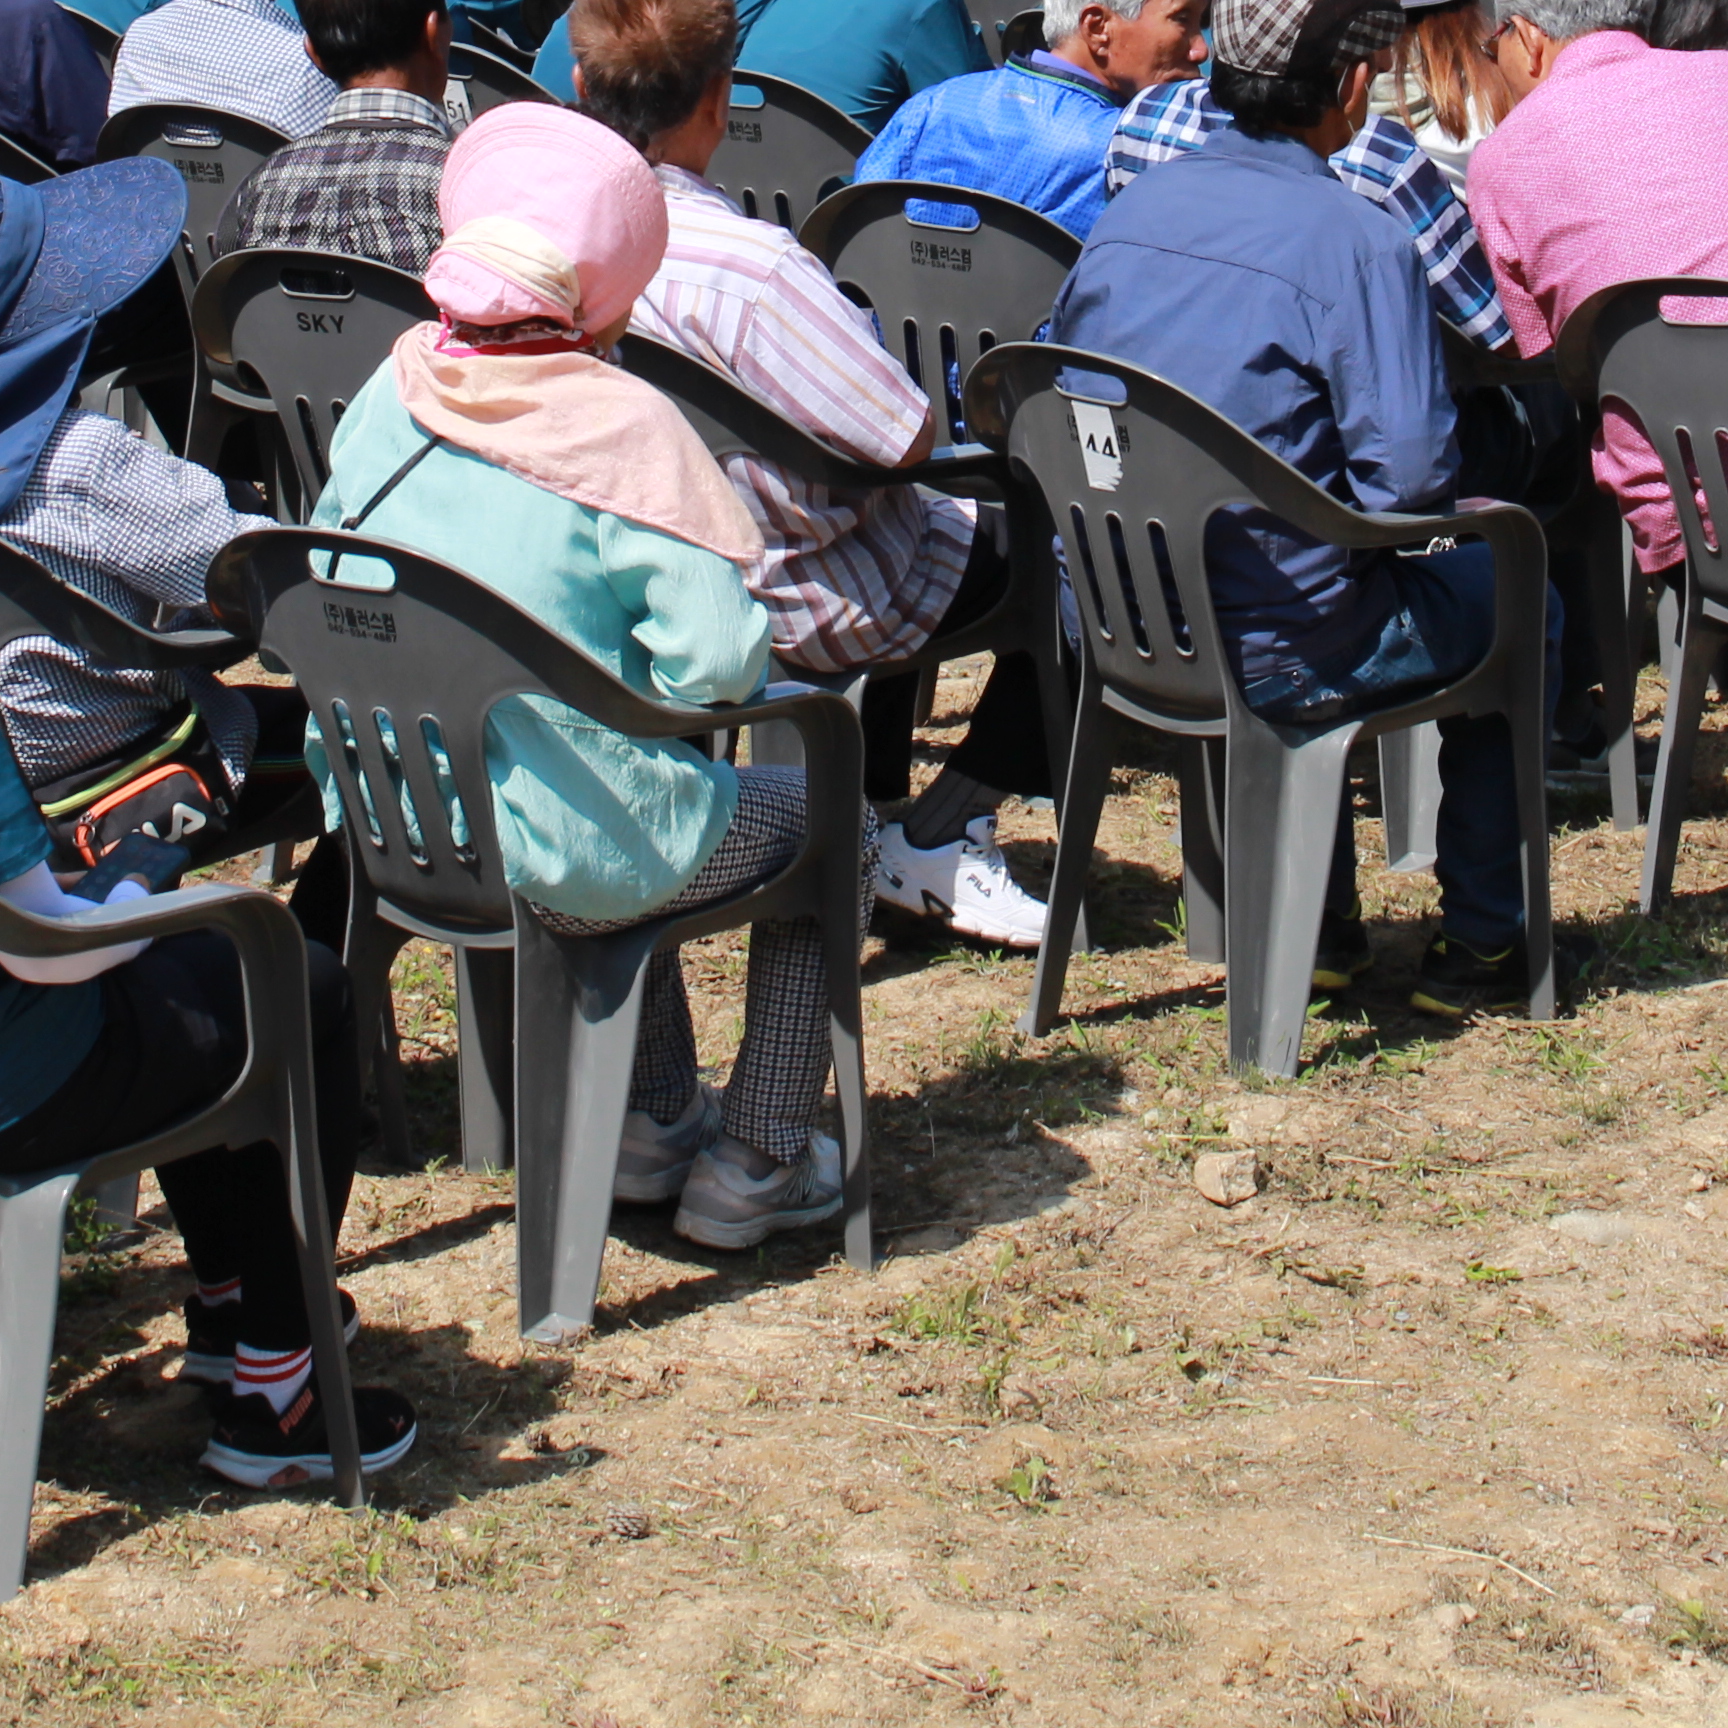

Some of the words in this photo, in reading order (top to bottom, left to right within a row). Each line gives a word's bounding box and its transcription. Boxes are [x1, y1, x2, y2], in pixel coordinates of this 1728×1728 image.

[446, 100, 468, 126] 51
[910, 240, 971, 264] (주)플러스컴
[296, 312, 344, 334] SKY
[323, 601, 396, 634] (주)플러스컴
[966, 872, 991, 899] FILA
